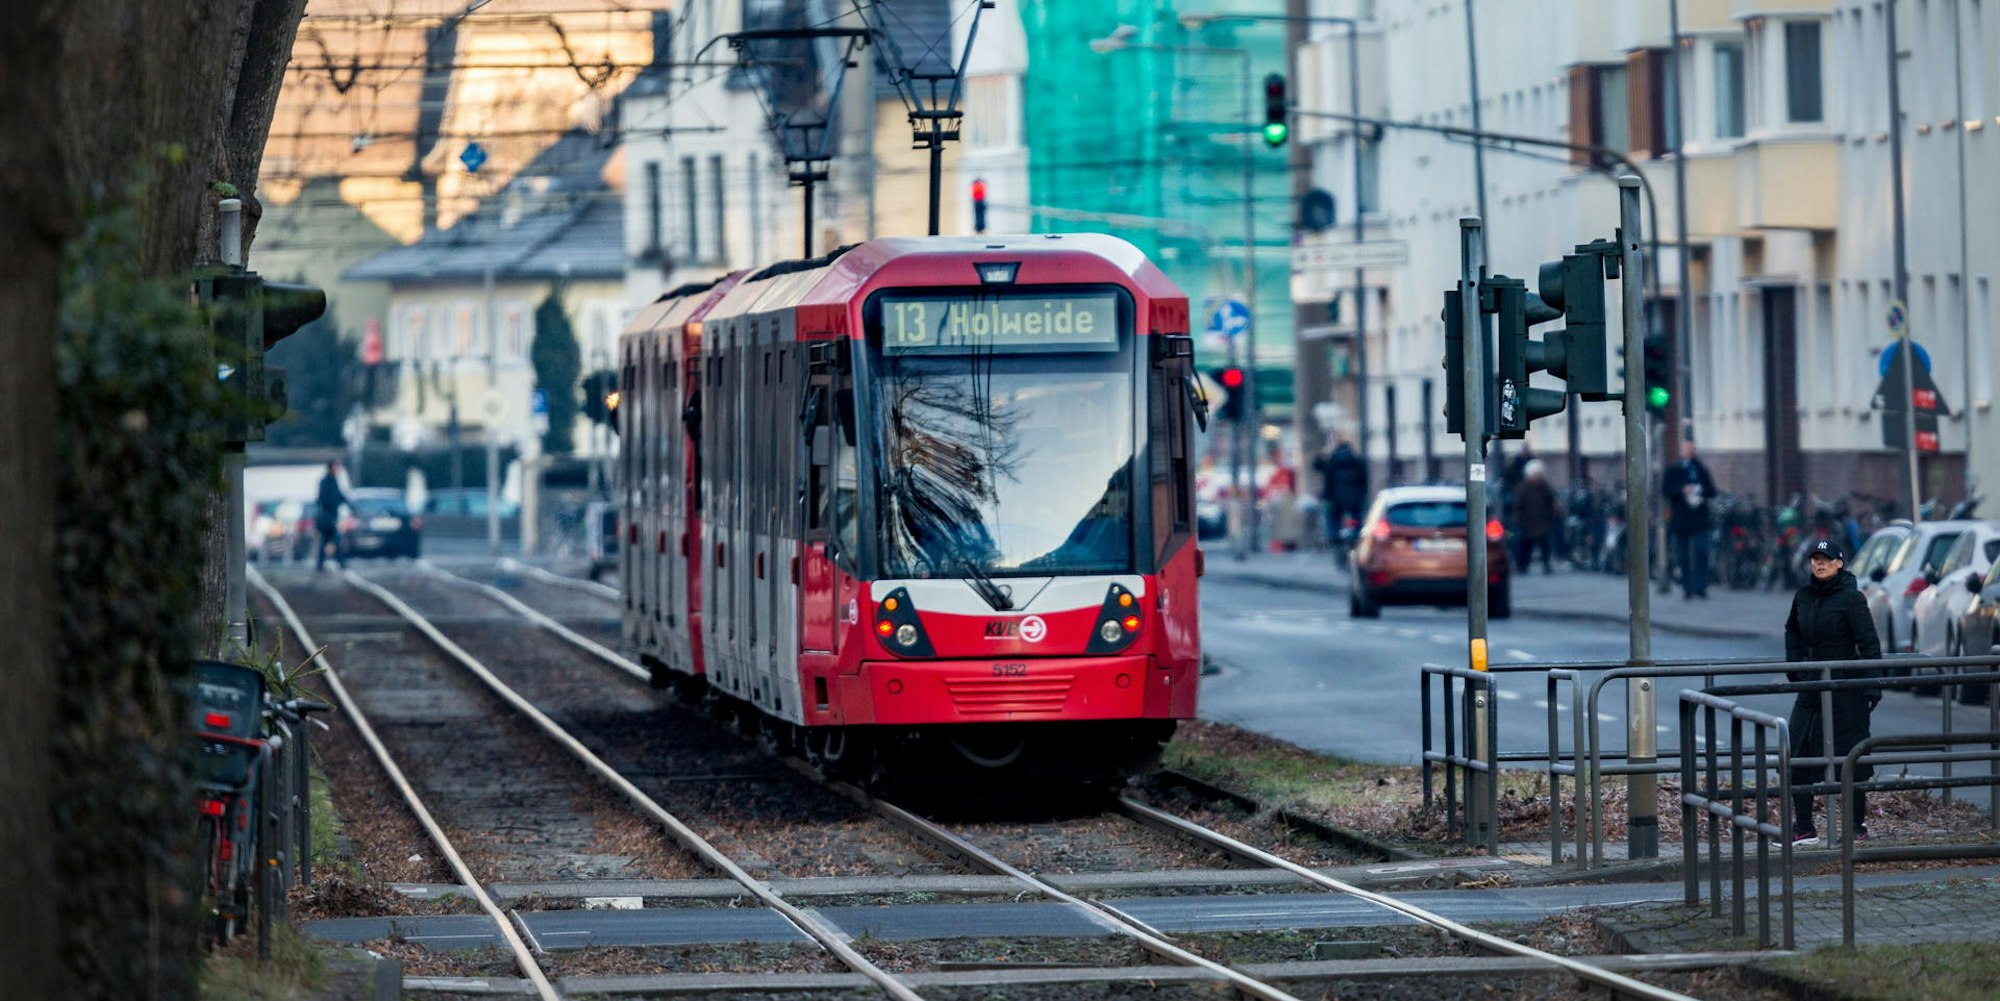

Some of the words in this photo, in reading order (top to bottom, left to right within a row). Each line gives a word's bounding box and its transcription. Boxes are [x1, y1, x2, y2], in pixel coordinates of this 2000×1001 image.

[894, 302, 926, 342] 13
[951, 302, 1095, 336] Holweide
[993, 664, 1027, 677] 5152
